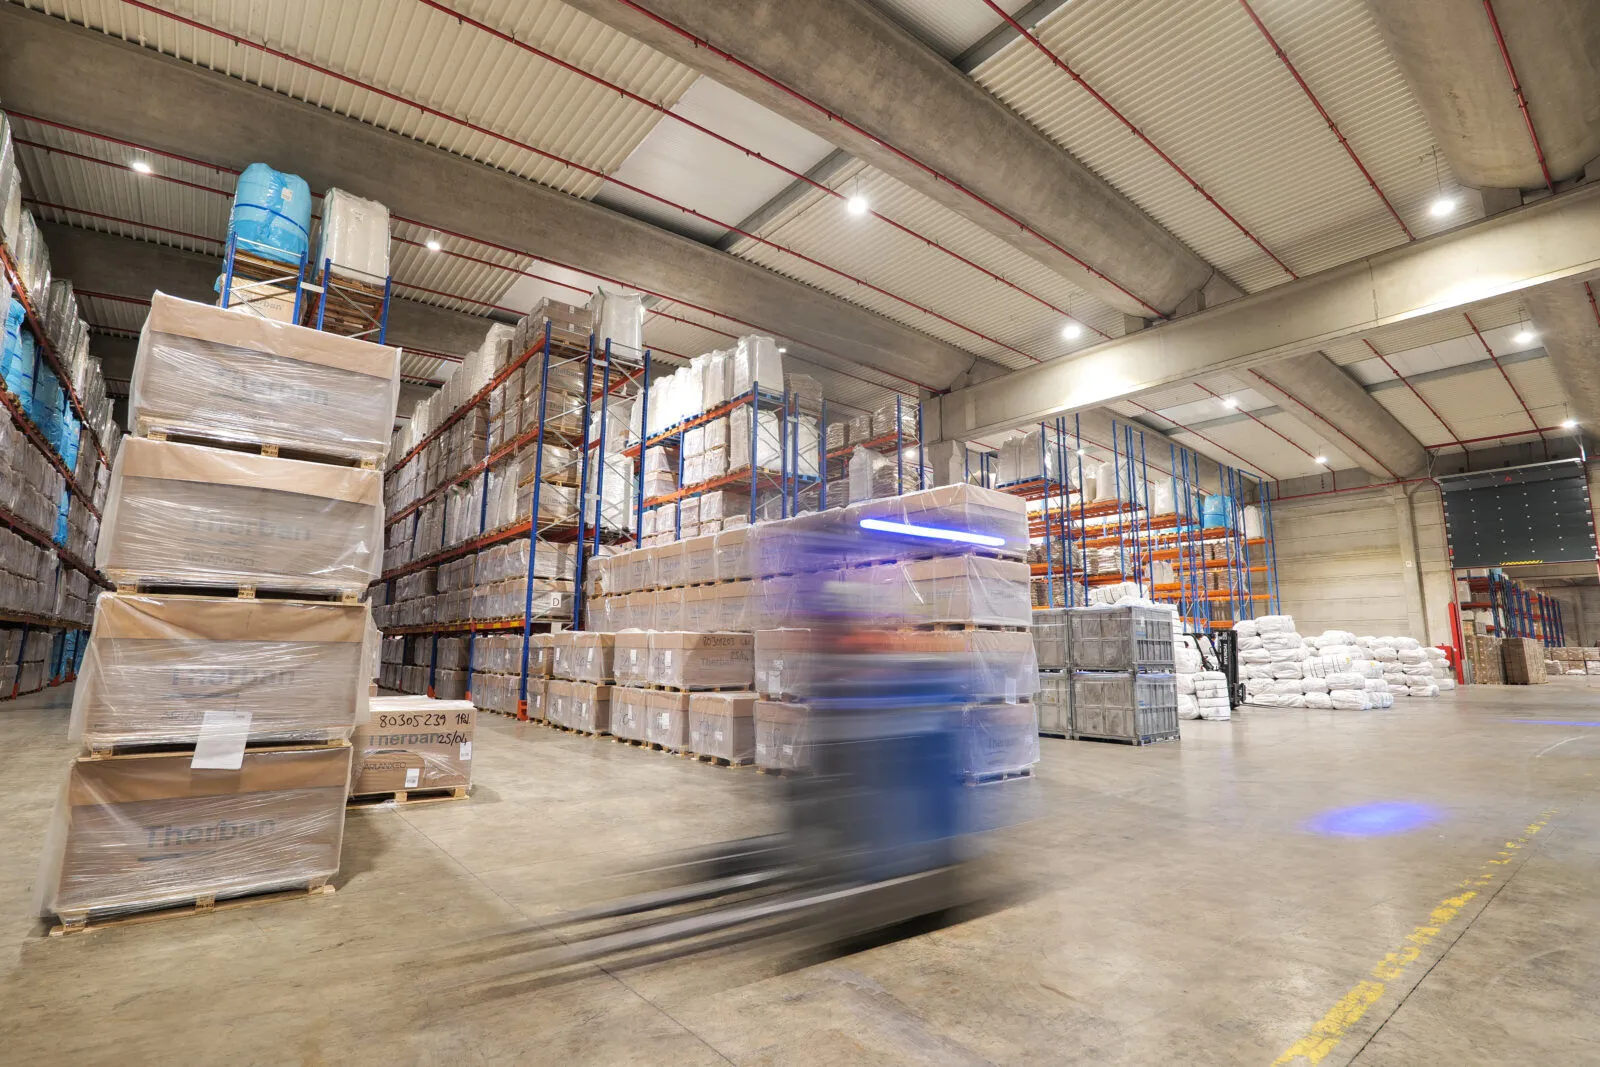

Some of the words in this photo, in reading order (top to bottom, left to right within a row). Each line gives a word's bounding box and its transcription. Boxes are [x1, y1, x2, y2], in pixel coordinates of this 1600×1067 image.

[379, 713, 447, 728] 80305239
[438, 730, 468, 746] 25/04
[142, 819, 276, 848] Therban
